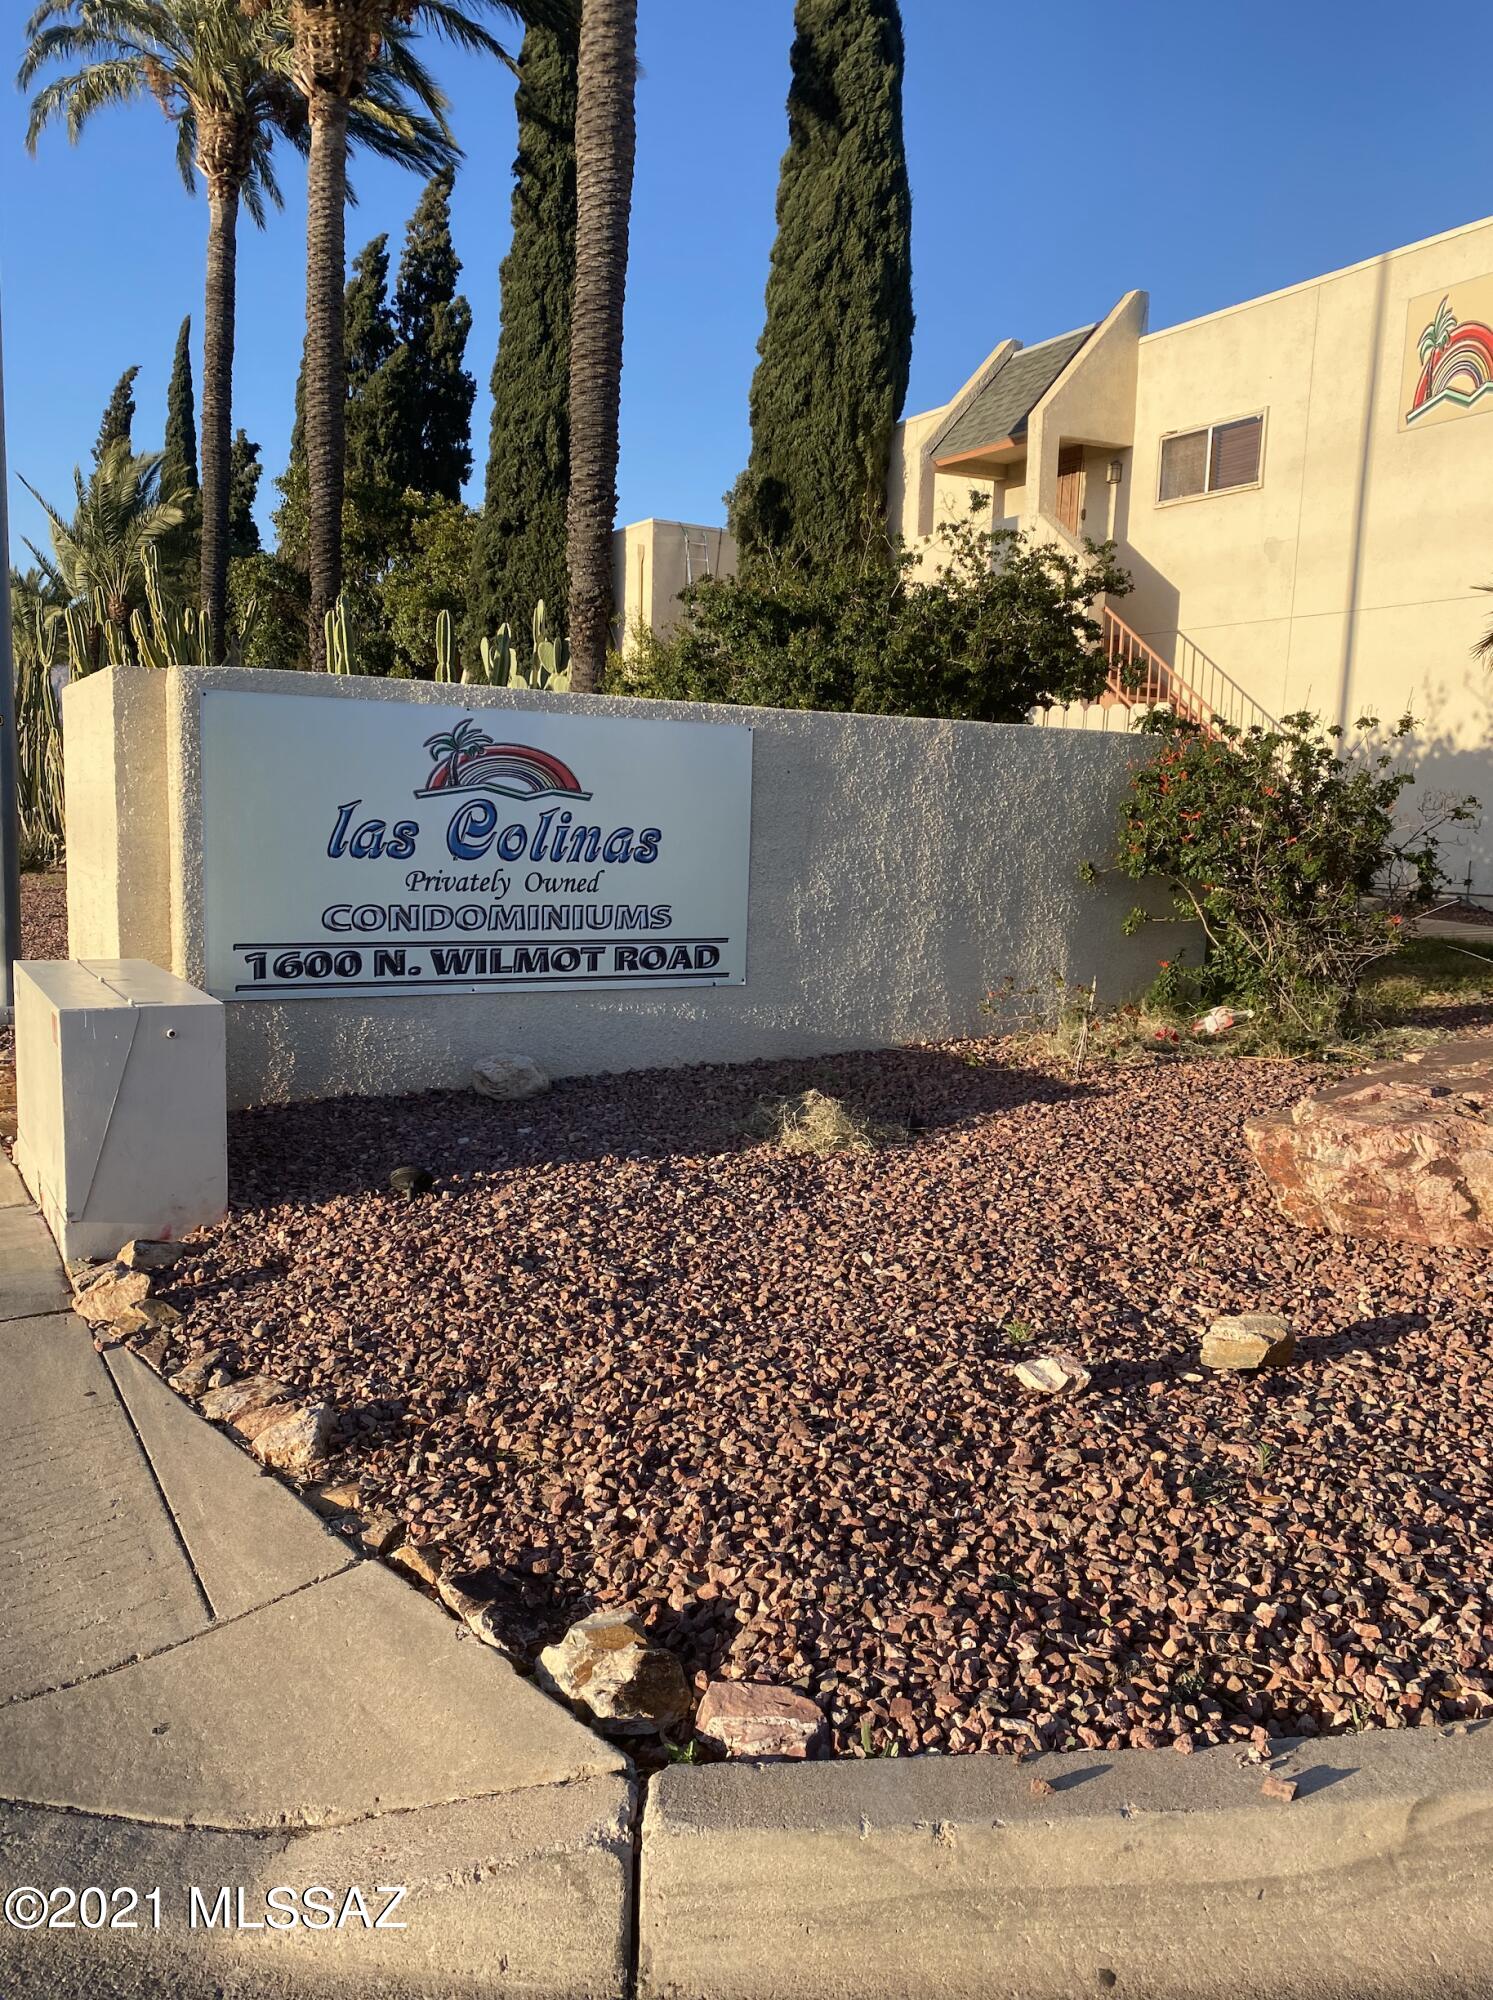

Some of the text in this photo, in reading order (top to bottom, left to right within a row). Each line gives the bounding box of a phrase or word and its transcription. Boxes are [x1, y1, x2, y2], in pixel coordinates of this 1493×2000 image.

[327, 798, 662, 863] las Colinas
[405, 869, 605, 899] Privately Owned
[321, 904, 672, 932] CONDOMINIUMS
[244, 944, 721, 981] 1600 N. WILMOT ROAD
